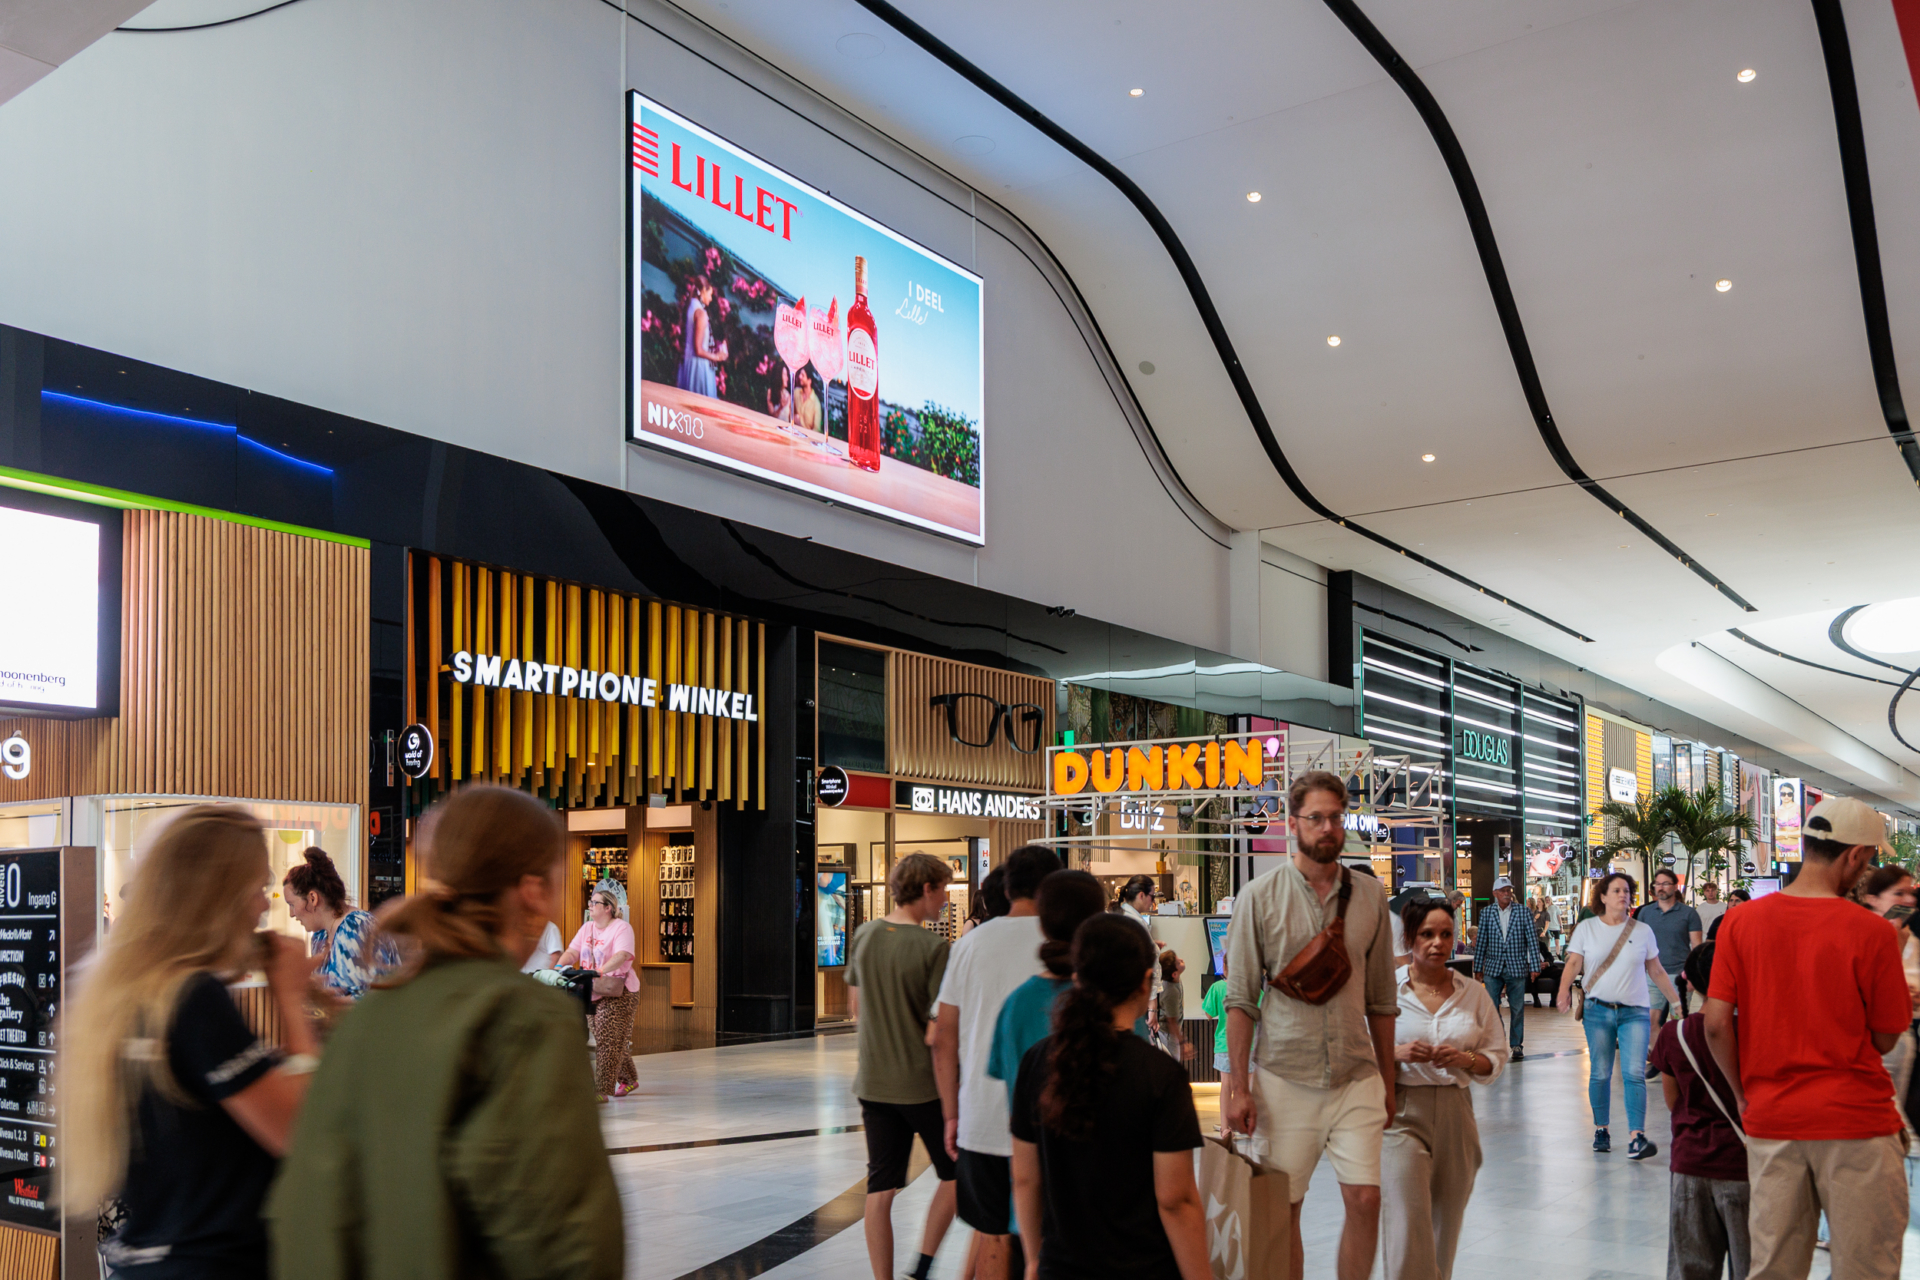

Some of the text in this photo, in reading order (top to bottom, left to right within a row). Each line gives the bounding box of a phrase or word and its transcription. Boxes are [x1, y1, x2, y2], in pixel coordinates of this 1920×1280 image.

[671, 141, 798, 242] LILLET
[908, 280, 945, 314] I DEEL
[782, 313, 802, 329] LILLET
[813, 321, 835, 337] LILLET
[848, 350, 875, 371] LILLET
[647, 400, 704, 440] NIX18
[453, 650, 758, 722] SMARTPHONE WINKEL
[1463, 729, 1508, 766] DOUGLAS
[938, 789, 1041, 820] HANS ANDERS
[1359, 814, 1378, 832] OWN
[1778, 851, 1799, 859] LIVERA
[7, 862, 21, 908] 0
[28, 890, 57, 909] Ingang G
[0, 1057, 9, 1069] lick
[14, 1059, 35, 1071] Services
[17, 1149, 28, 1162] Oost
[14, 1178, 39, 1199] Westfield
